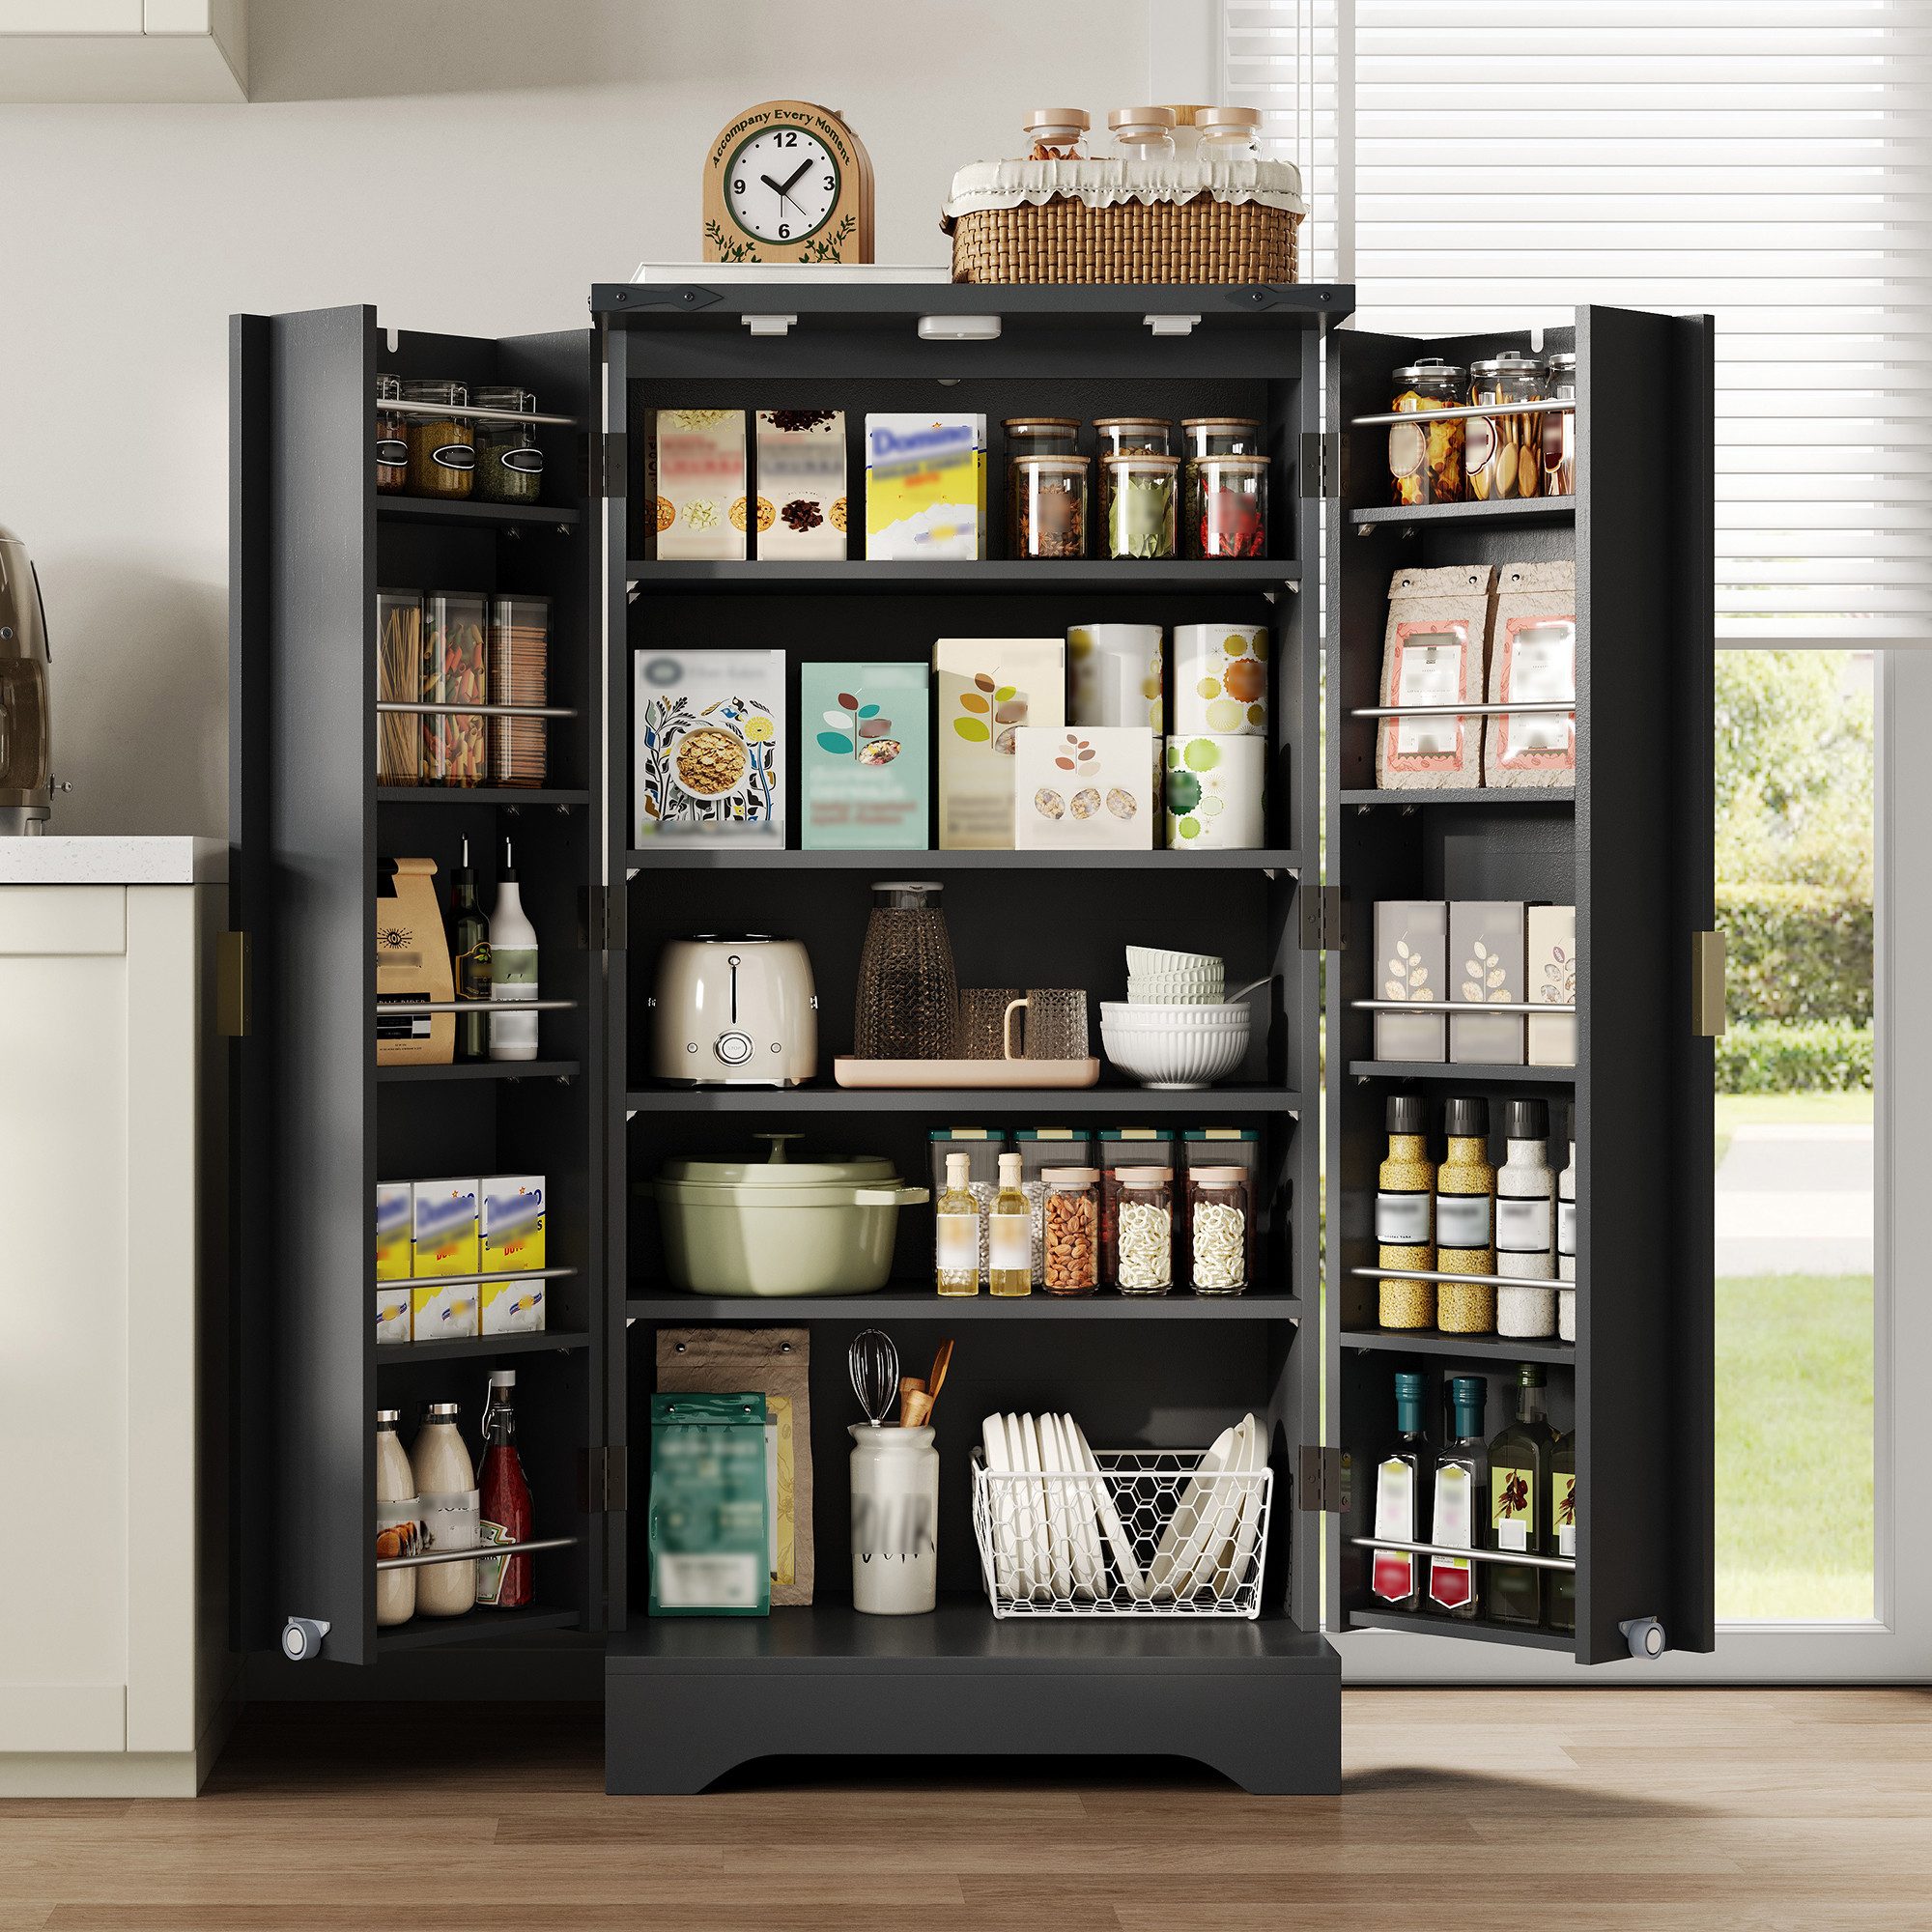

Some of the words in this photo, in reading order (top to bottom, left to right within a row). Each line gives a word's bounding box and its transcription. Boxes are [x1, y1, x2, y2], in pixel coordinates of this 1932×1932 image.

[713, 111, 772, 168] Accompany
[774, 109, 814, 126] Every
[815, 116, 850, 166] Moment
[773, 132, 797, 148] 12
[733, 179, 746, 194] 9
[823, 176, 835, 191] 3
[778, 224, 790, 239] 6
